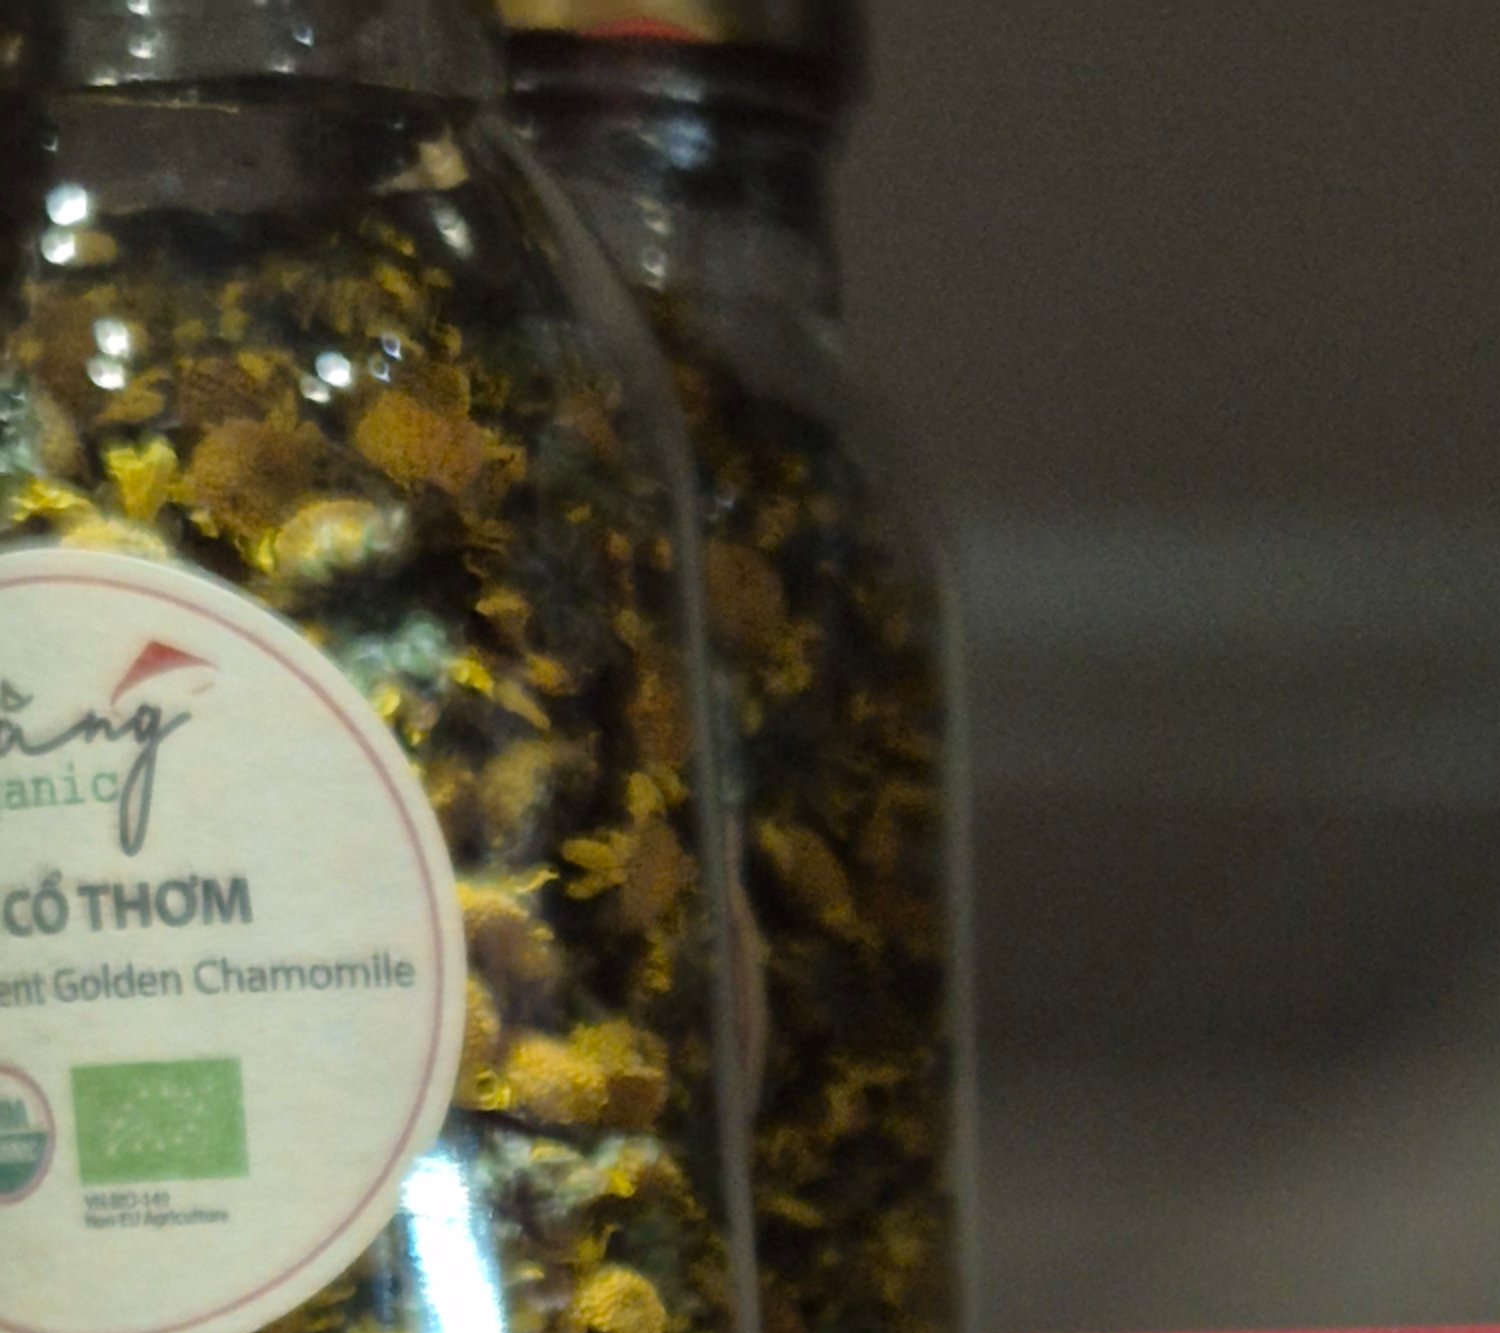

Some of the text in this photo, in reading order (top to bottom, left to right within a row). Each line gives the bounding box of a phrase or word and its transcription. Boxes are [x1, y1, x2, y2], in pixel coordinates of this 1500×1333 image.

[78, 874, 253, 933] THƠM
[53, 962, 182, 1002] Golden
[193, 952, 415, 995] Chamomile
